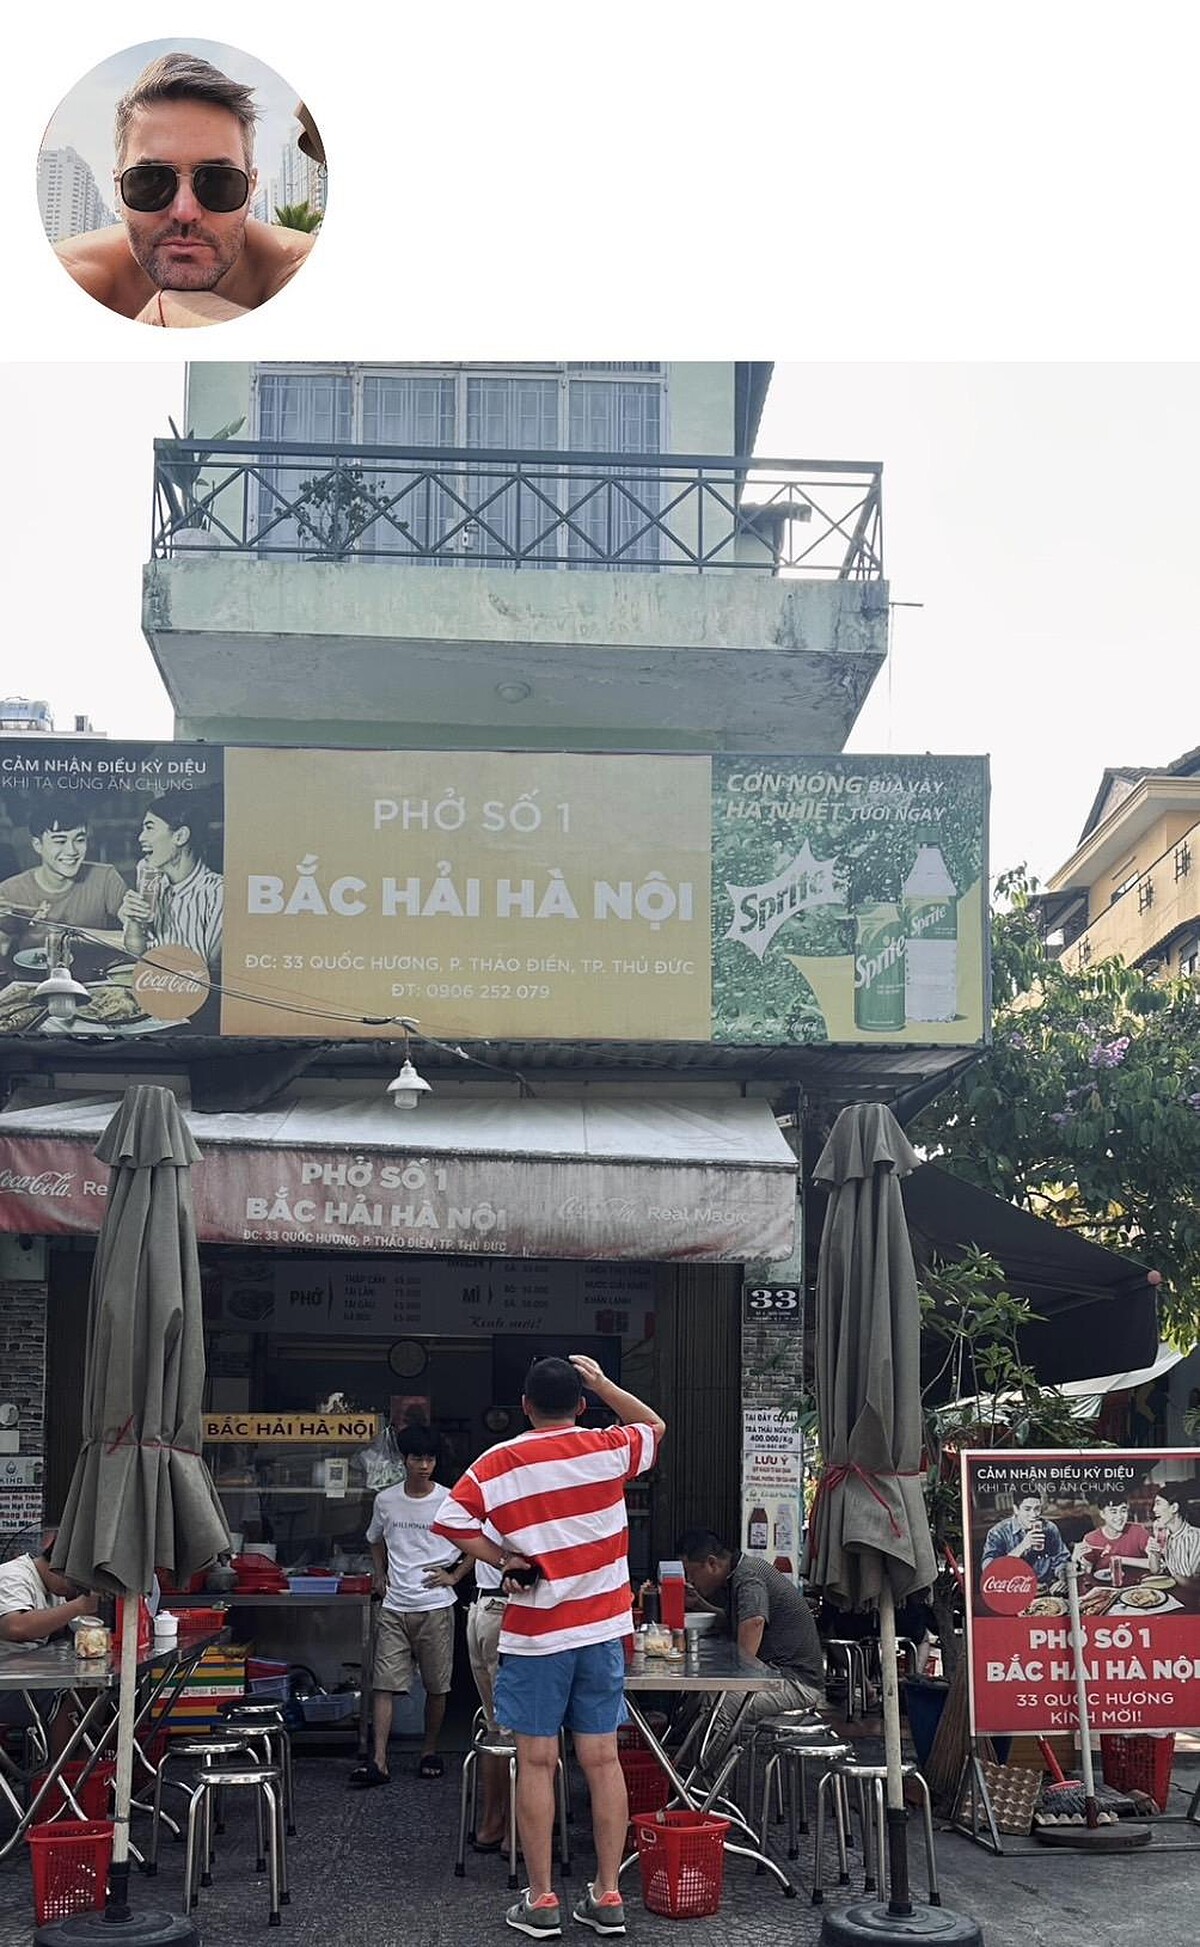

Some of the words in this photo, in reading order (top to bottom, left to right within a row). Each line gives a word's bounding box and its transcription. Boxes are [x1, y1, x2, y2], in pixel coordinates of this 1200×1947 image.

[2, 755, 39, 773] CẢM
[45, 754, 92, 777] NHẬN
[168, 757, 207, 777] DIỆU
[2, 776, 29, 789] KHI
[34, 777, 53, 789] TA
[135, 777, 194, 792] CHUNG
[373, 788, 466, 833] PHỞ
[482, 788, 542, 834] SỐ
[557, 802, 571, 834] 1
[247, 854, 368, 917] BẮC
[382, 861, 480, 918] HẢI
[497, 868, 580, 920] HÀ
[594, 870, 693, 931] NỘI
[738, 867, 827, 935] Sprite
[911, 904, 948, 938] Sprite
[244, 953, 278, 969] ĐC:
[282, 954, 305, 970] 33
[309, 949, 366, 971] QUỐC
[370, 955, 443, 974] HƯƠNG,
[654, 957, 696, 976] ĐỨC
[855, 934, 906, 989] Sprite
[391, 983, 422, 999] ĐT:
[426, 983, 474, 999] 0906
[480, 984, 512, 1000] 252
[516, 984, 551, 1000] 079
[302, 1155, 373, 1188] PHỞ
[380, 1158, 430, 1191] SỐ
[434, 1167, 448, 1192] 1
[246, 1185, 317, 1223] BẮC
[324, 1193, 383, 1227] HẢI
[391, 1199, 440, 1230] HÀ
[447, 1202, 507, 1236] NỘI
[647, 1206, 689, 1222] Real
[750, 1289, 798, 1310] 33
[207, 1415, 249, 1436] BẮC
[256, 1416, 293, 1436] HẢI
[300, 1419, 330, 1436] HÀ
[338, 1419, 374, 1439] NỘI
[977, 1464, 1007, 1480] CẢM
[1010, 1464, 1048, 1482] NHẬN
[1104, 1464, 1135, 1481] DIỆU
[978, 1481, 999, 1492] KHI
[1003, 1482, 1018, 1493] TA
[1080, 1480, 1126, 1494] CHUNG
[983, 1574, 1033, 1595] Coca-Cola
[1094, 1622, 1134, 1650] SỐ
[1137, 1628, 1151, 1649] 1
[986, 1653, 1044, 1683] BẮC
[1106, 1655, 1148, 1681] HÀ
[1016, 1694, 1038, 1707] 33
[1105, 1690, 1174, 1706] HƯƠNG
[1101, 1706, 1142, 1724] MỜI!
